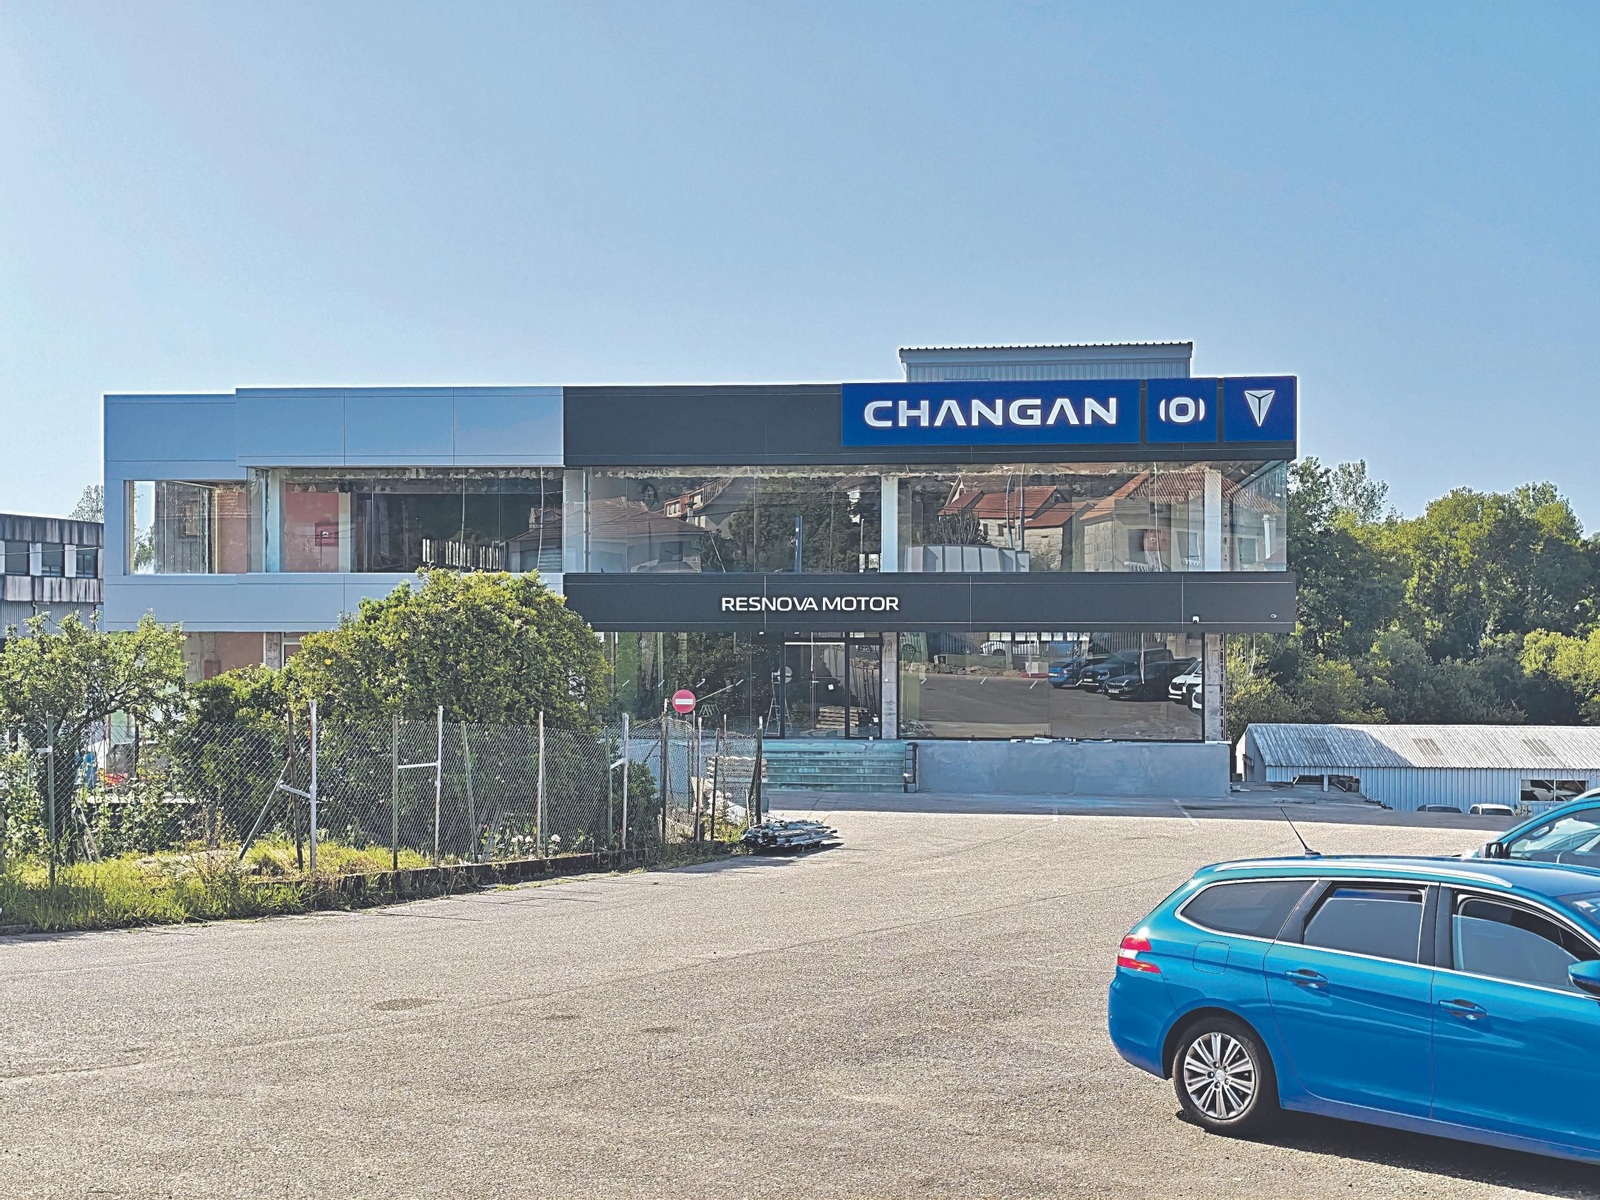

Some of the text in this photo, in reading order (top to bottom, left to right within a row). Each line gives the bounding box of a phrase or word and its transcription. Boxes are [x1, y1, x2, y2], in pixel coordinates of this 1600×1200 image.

[863, 397, 1117, 428] CHANGAN
[721, 596, 900, 612] RESNOVA MOTOR
